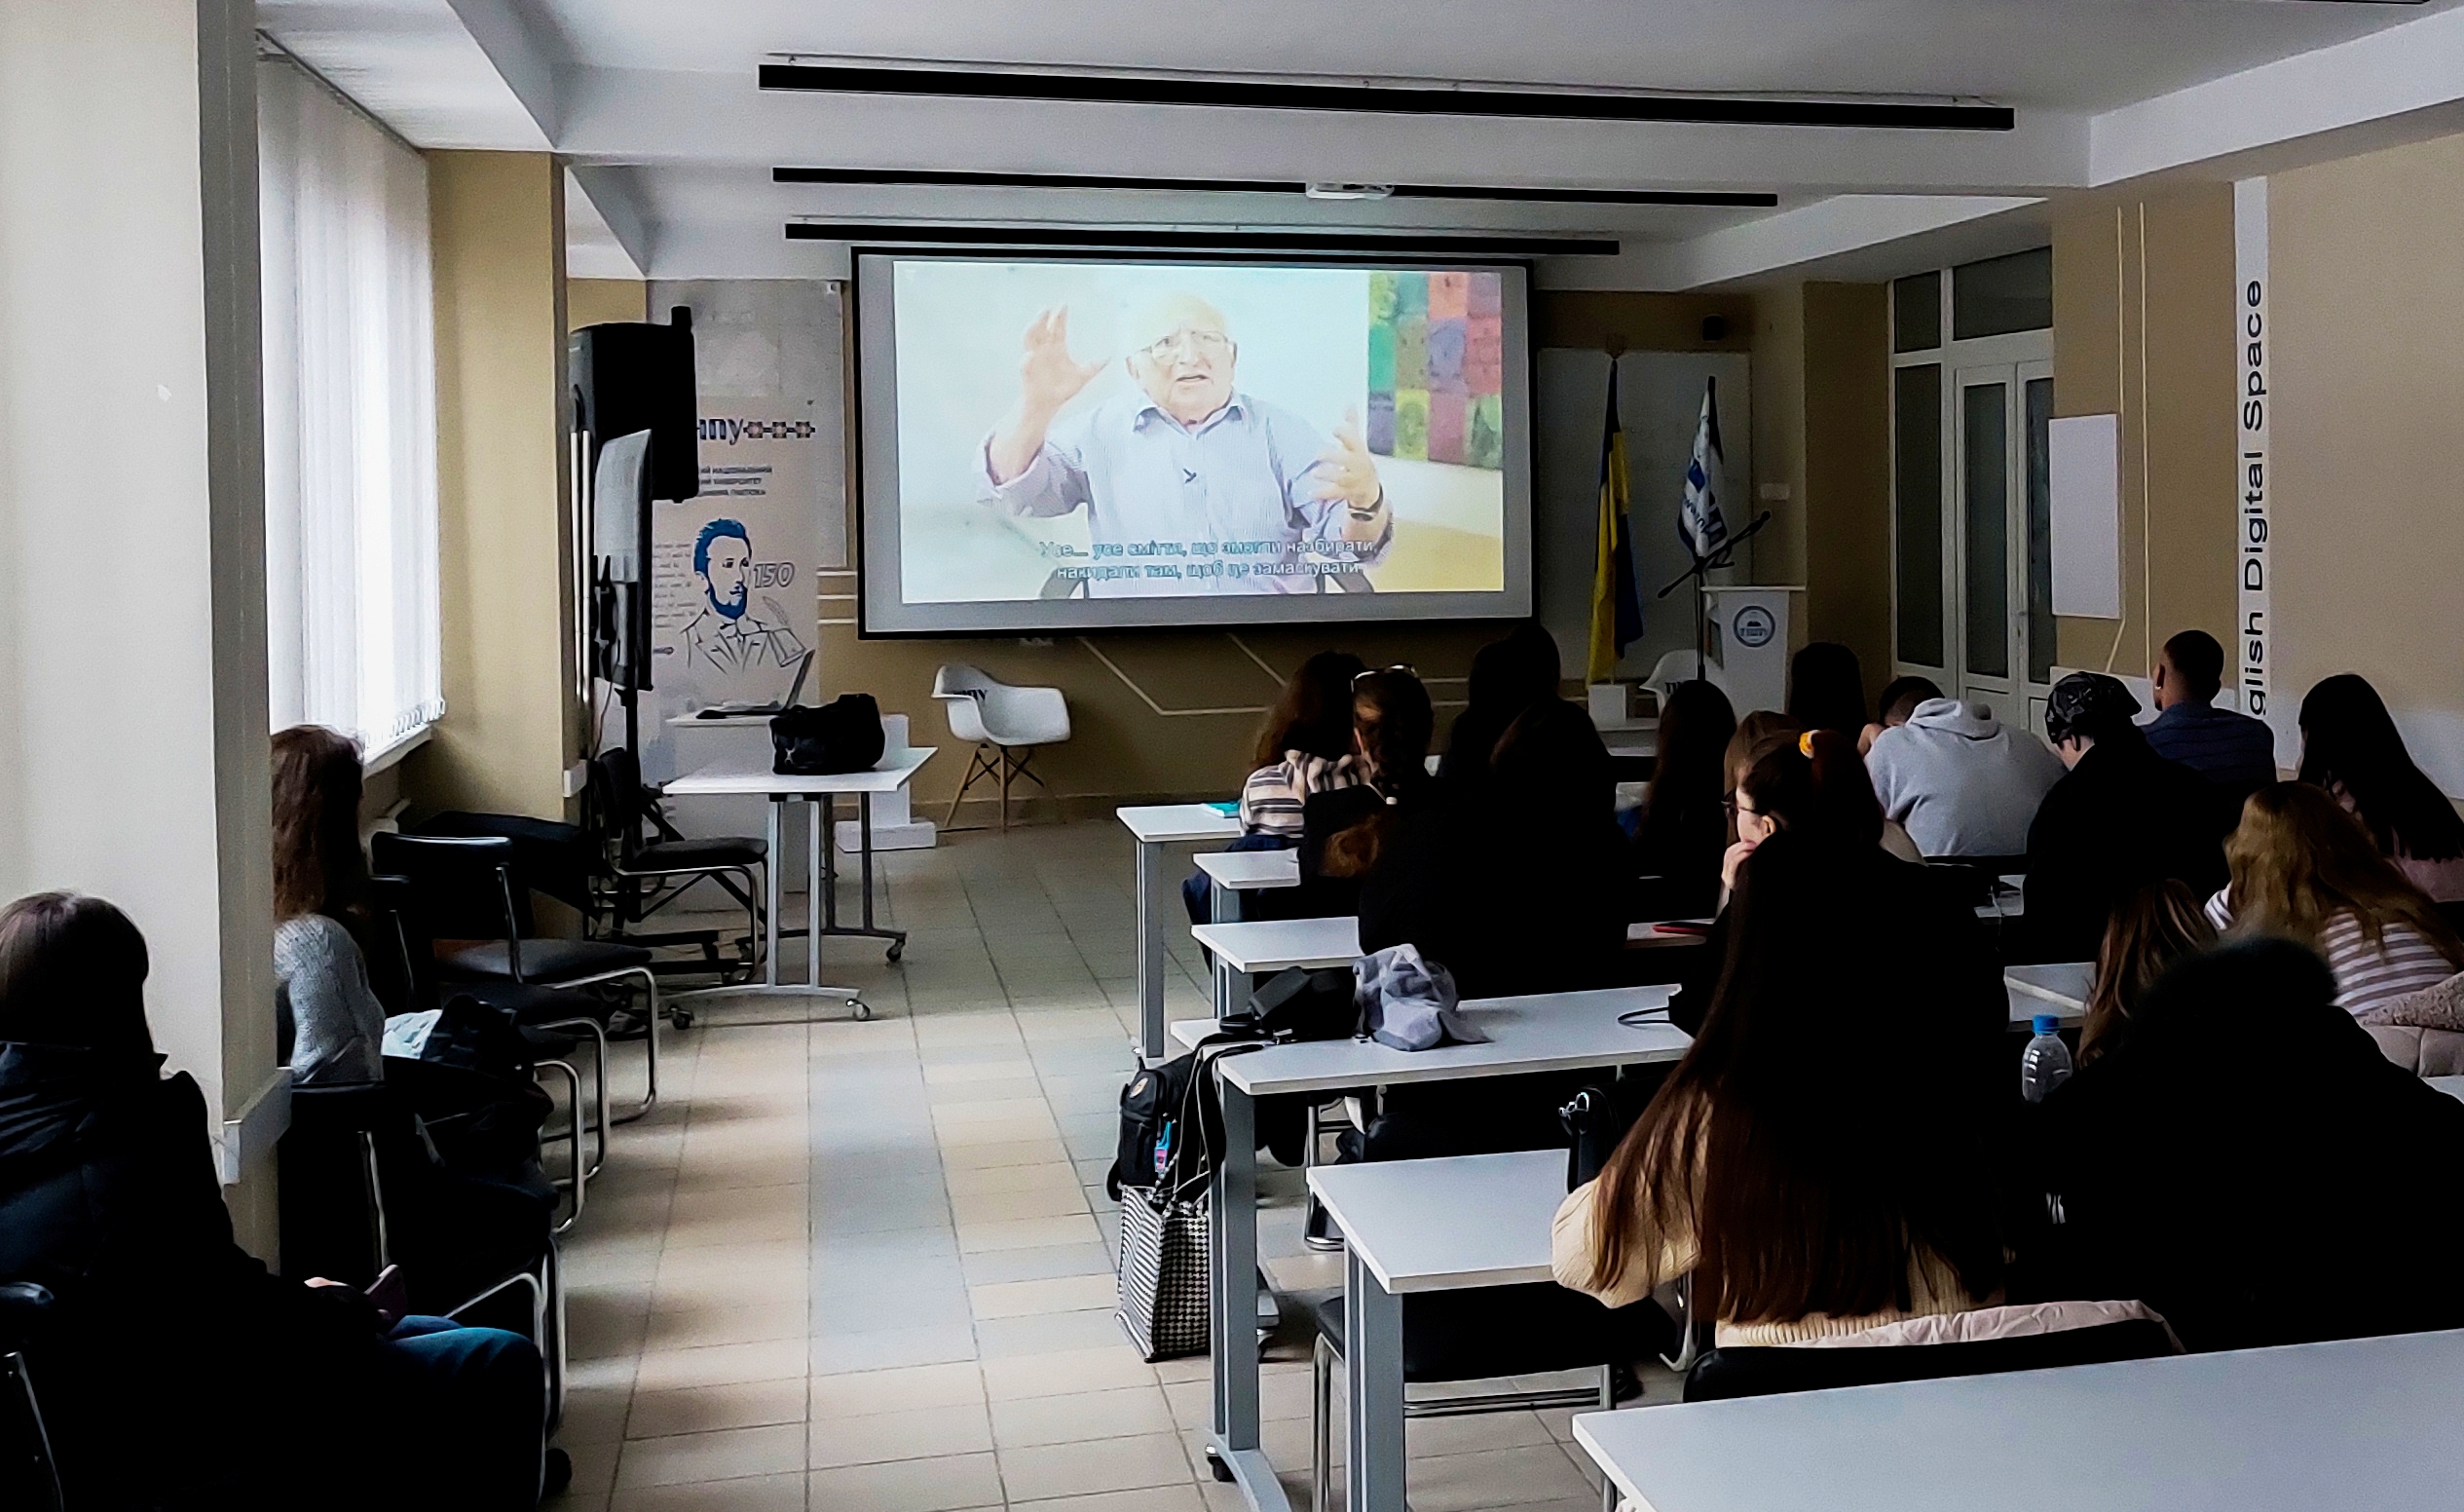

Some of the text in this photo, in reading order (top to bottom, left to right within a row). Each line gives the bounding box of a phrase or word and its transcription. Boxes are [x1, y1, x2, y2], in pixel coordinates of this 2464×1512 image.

[2243, 279, 2268, 716] glish Digital Space
[1191, 541, 1218, 557] що
[753, 561, 795, 588] 150
[1186, 559, 1224, 578] щоб
[1227, 562, 1251, 578] це
